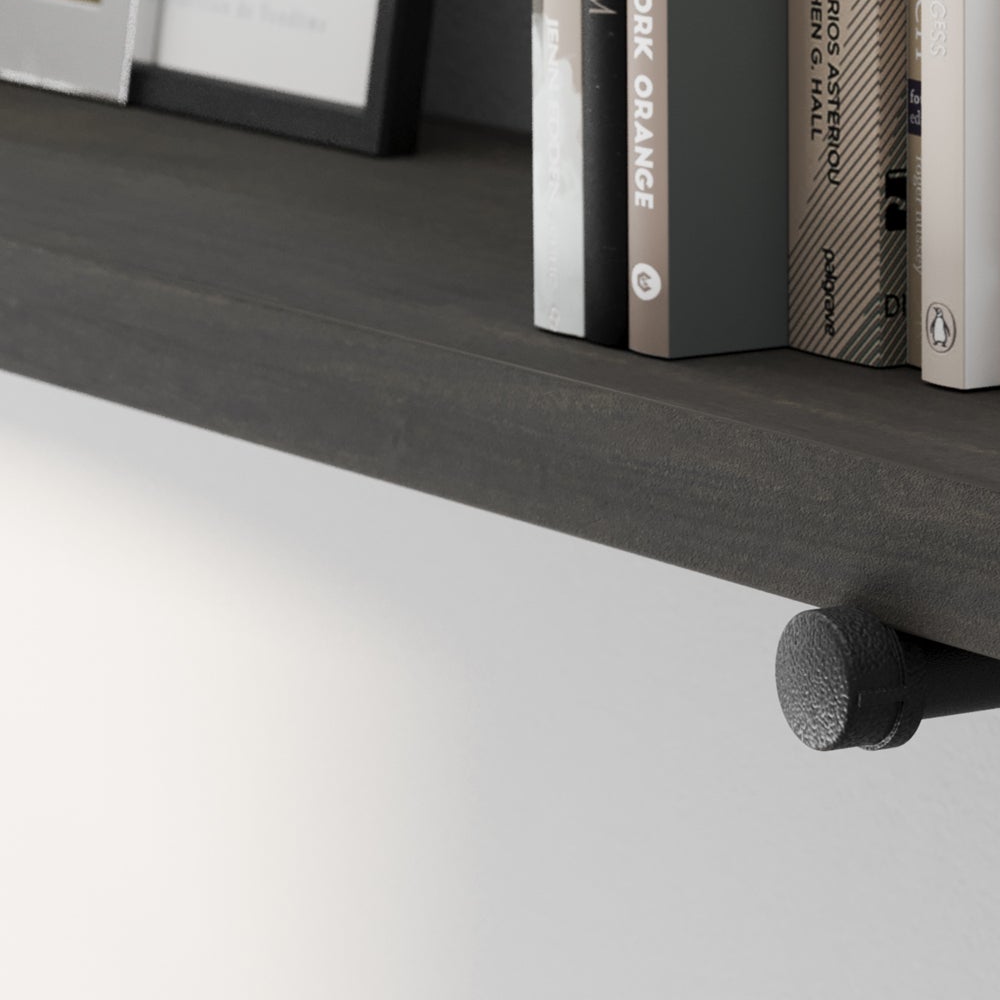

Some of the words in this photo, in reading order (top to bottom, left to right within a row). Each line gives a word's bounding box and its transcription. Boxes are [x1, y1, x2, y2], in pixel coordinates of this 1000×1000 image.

[811, 46, 823, 71] G.
[633, 74, 654, 210] ORANGE
[811, 78, 823, 141] HALL
[827, 61, 841, 187] ASTERIOU
